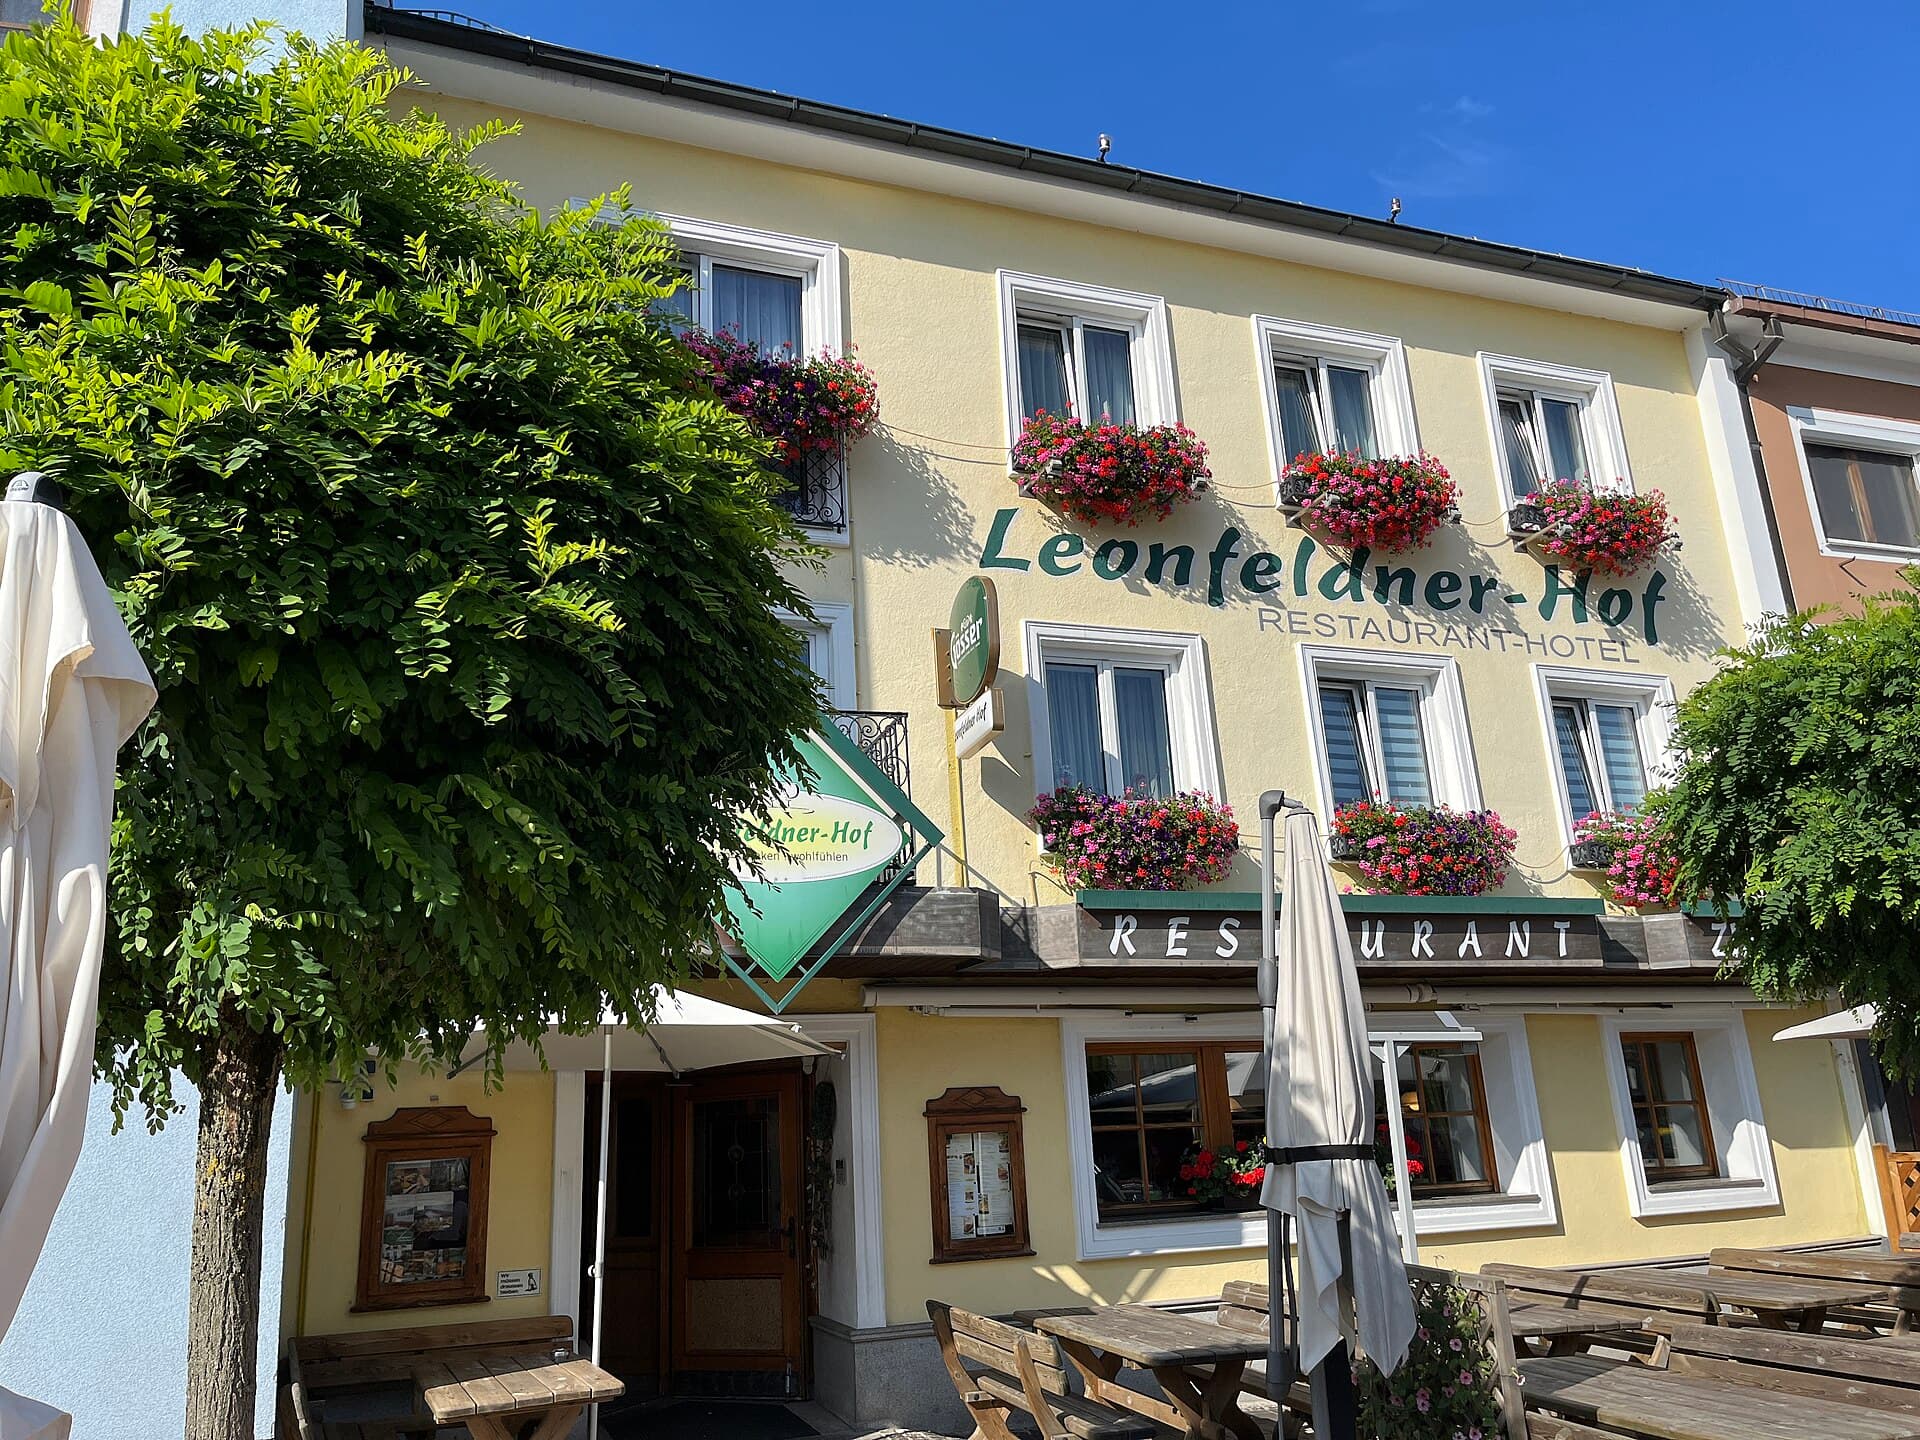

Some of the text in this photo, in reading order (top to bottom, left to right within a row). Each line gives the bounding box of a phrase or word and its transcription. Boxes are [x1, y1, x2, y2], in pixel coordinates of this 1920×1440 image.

[979, 507, 1666, 647] Leonfeldner-Hof
[1258, 607, 1640, 664] RESTAURANT-HOTEL
[1109, 914, 1571, 959] RESURANT
